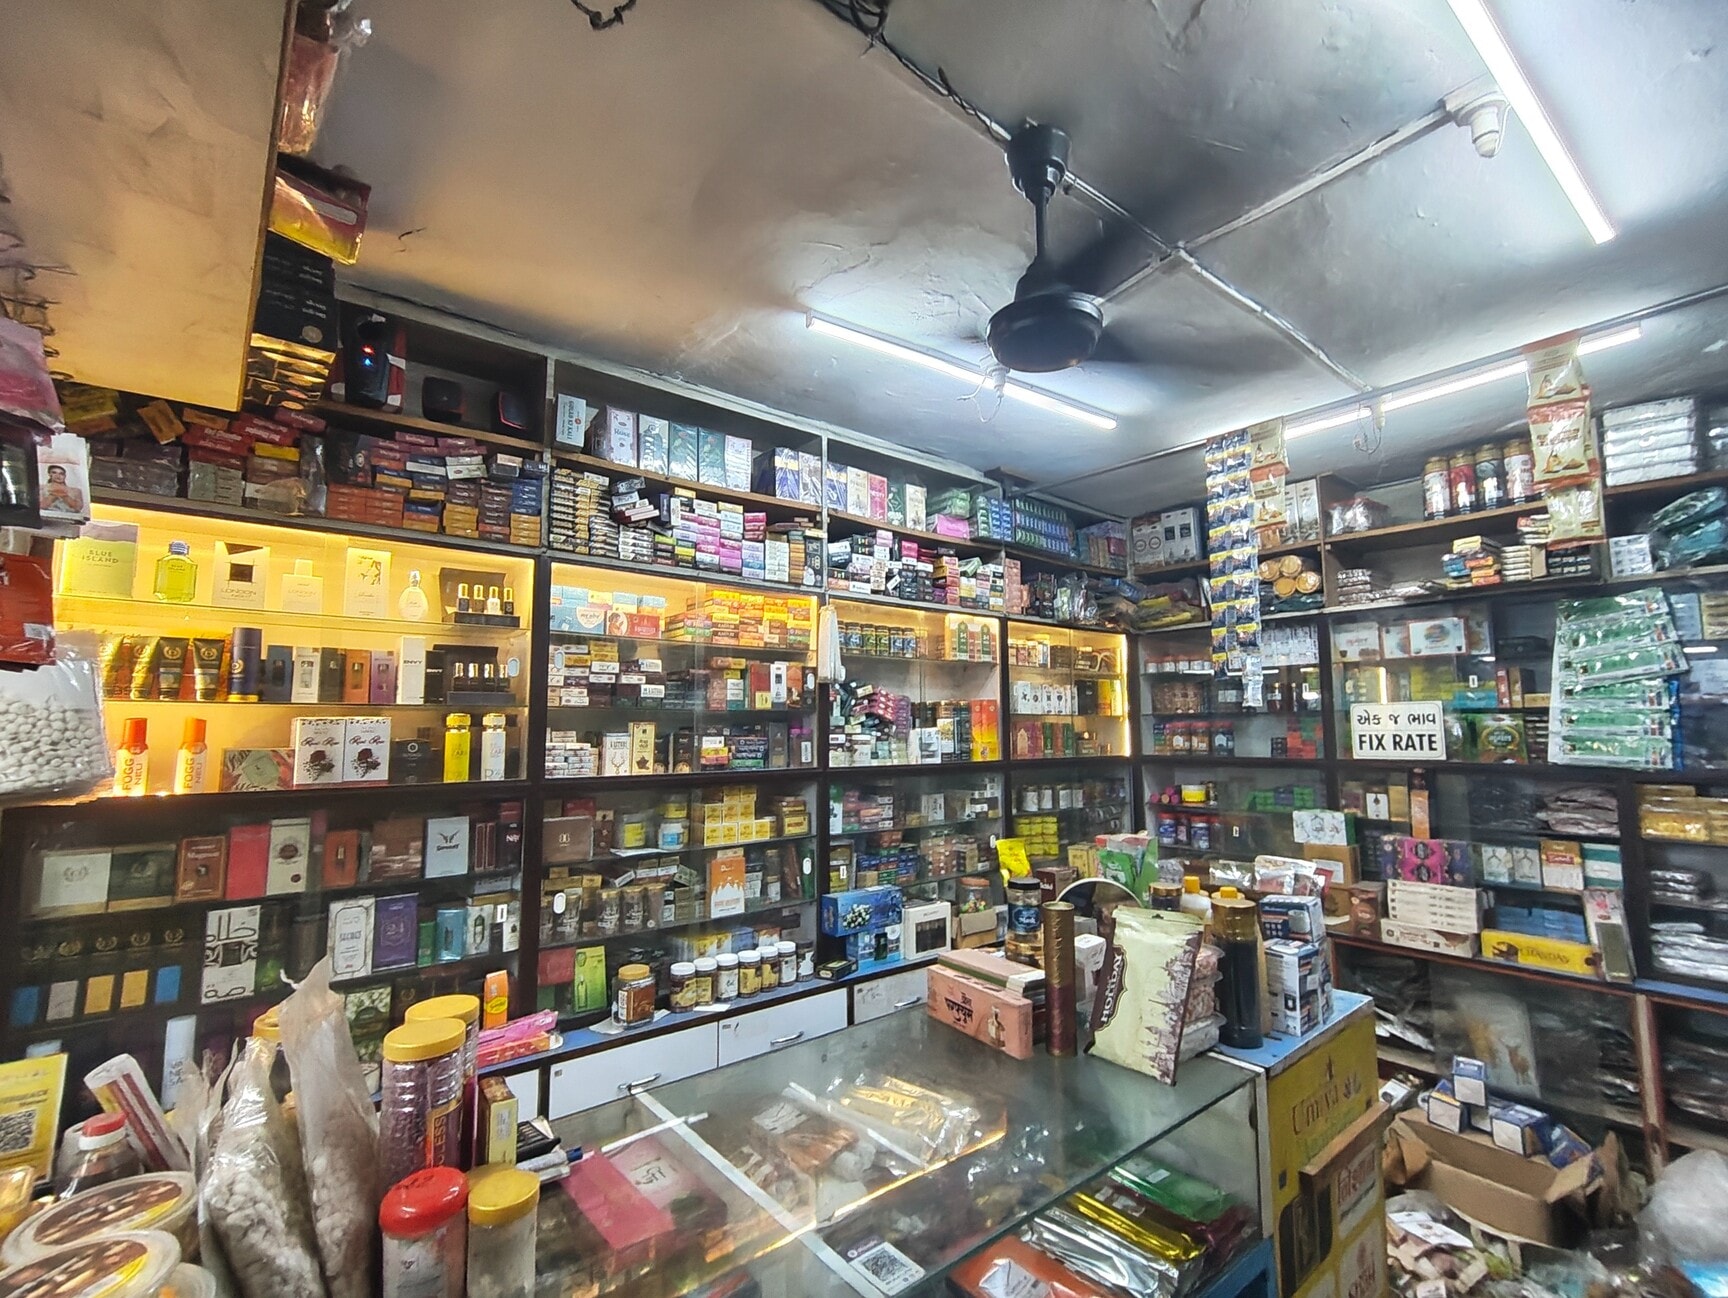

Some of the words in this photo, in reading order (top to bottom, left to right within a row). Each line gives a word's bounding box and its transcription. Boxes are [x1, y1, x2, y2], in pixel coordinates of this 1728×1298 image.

[81, 555, 120, 565] ISLAND
[88, 549, 113, 558] BLUE
[220, 588, 257, 596] LONDON
[1356, 709, 1382, 726] એક
[1388, 713, 1400, 725] જ
[1407, 713, 1436, 725] ભાવ
[1358, 733, 1387, 751] FIX
[1392, 733, 1438, 751] RATE
[121, 757, 136, 791] FOGG
[183, 757, 195, 789] FOGG
